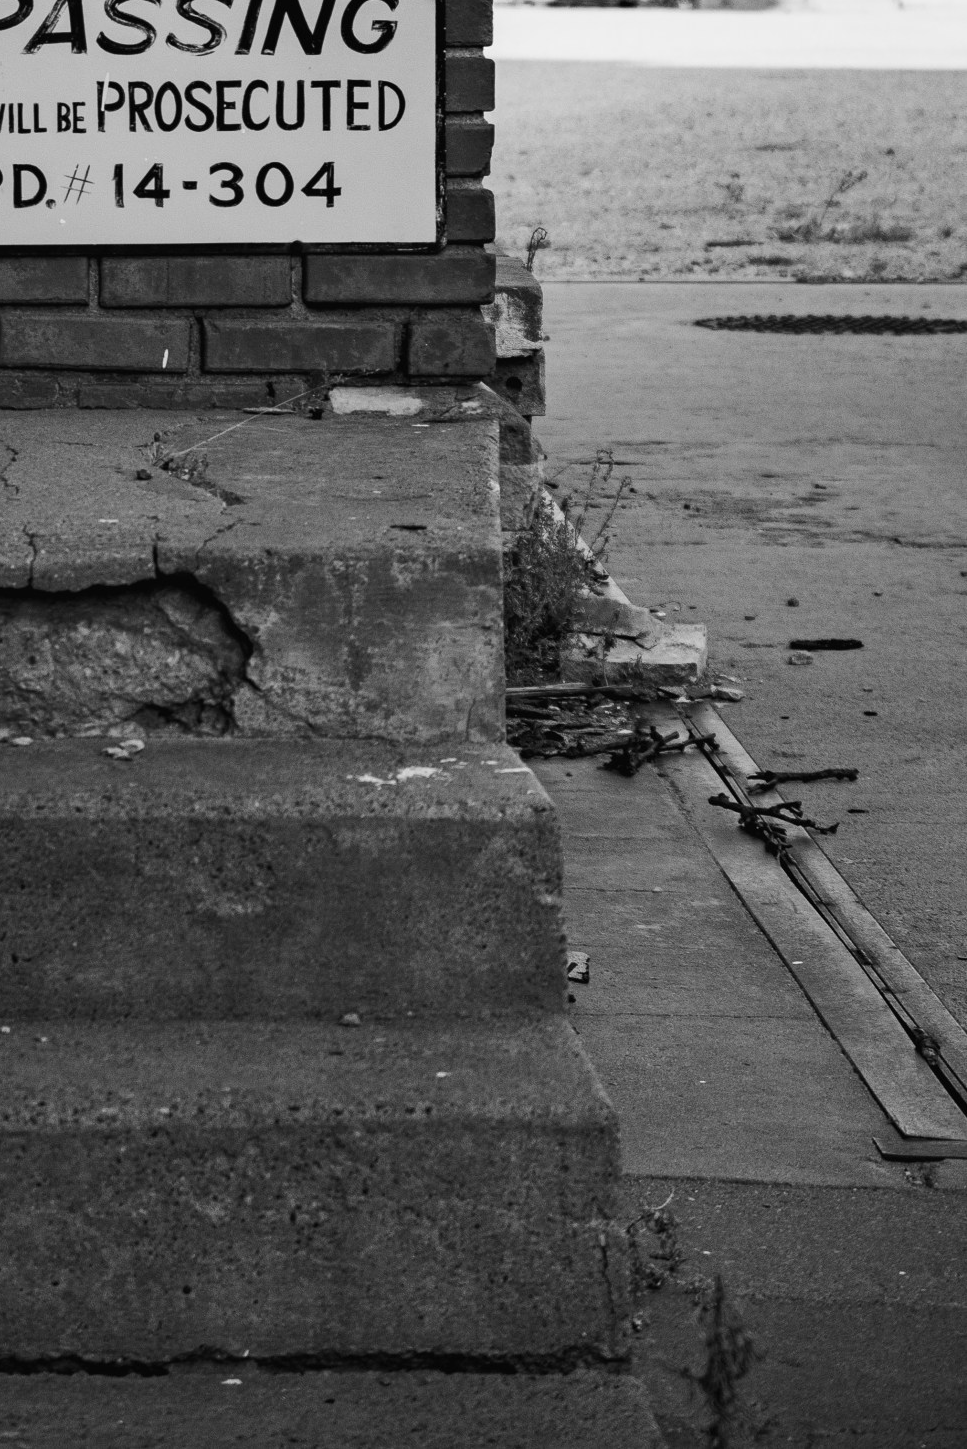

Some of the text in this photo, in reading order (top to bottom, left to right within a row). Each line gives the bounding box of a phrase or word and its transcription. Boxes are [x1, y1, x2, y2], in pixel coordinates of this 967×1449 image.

[56, 101, 87, 134] BE
[96, 79, 406, 133] PROSECUTED
[112, 161, 343, 209] 14-304
